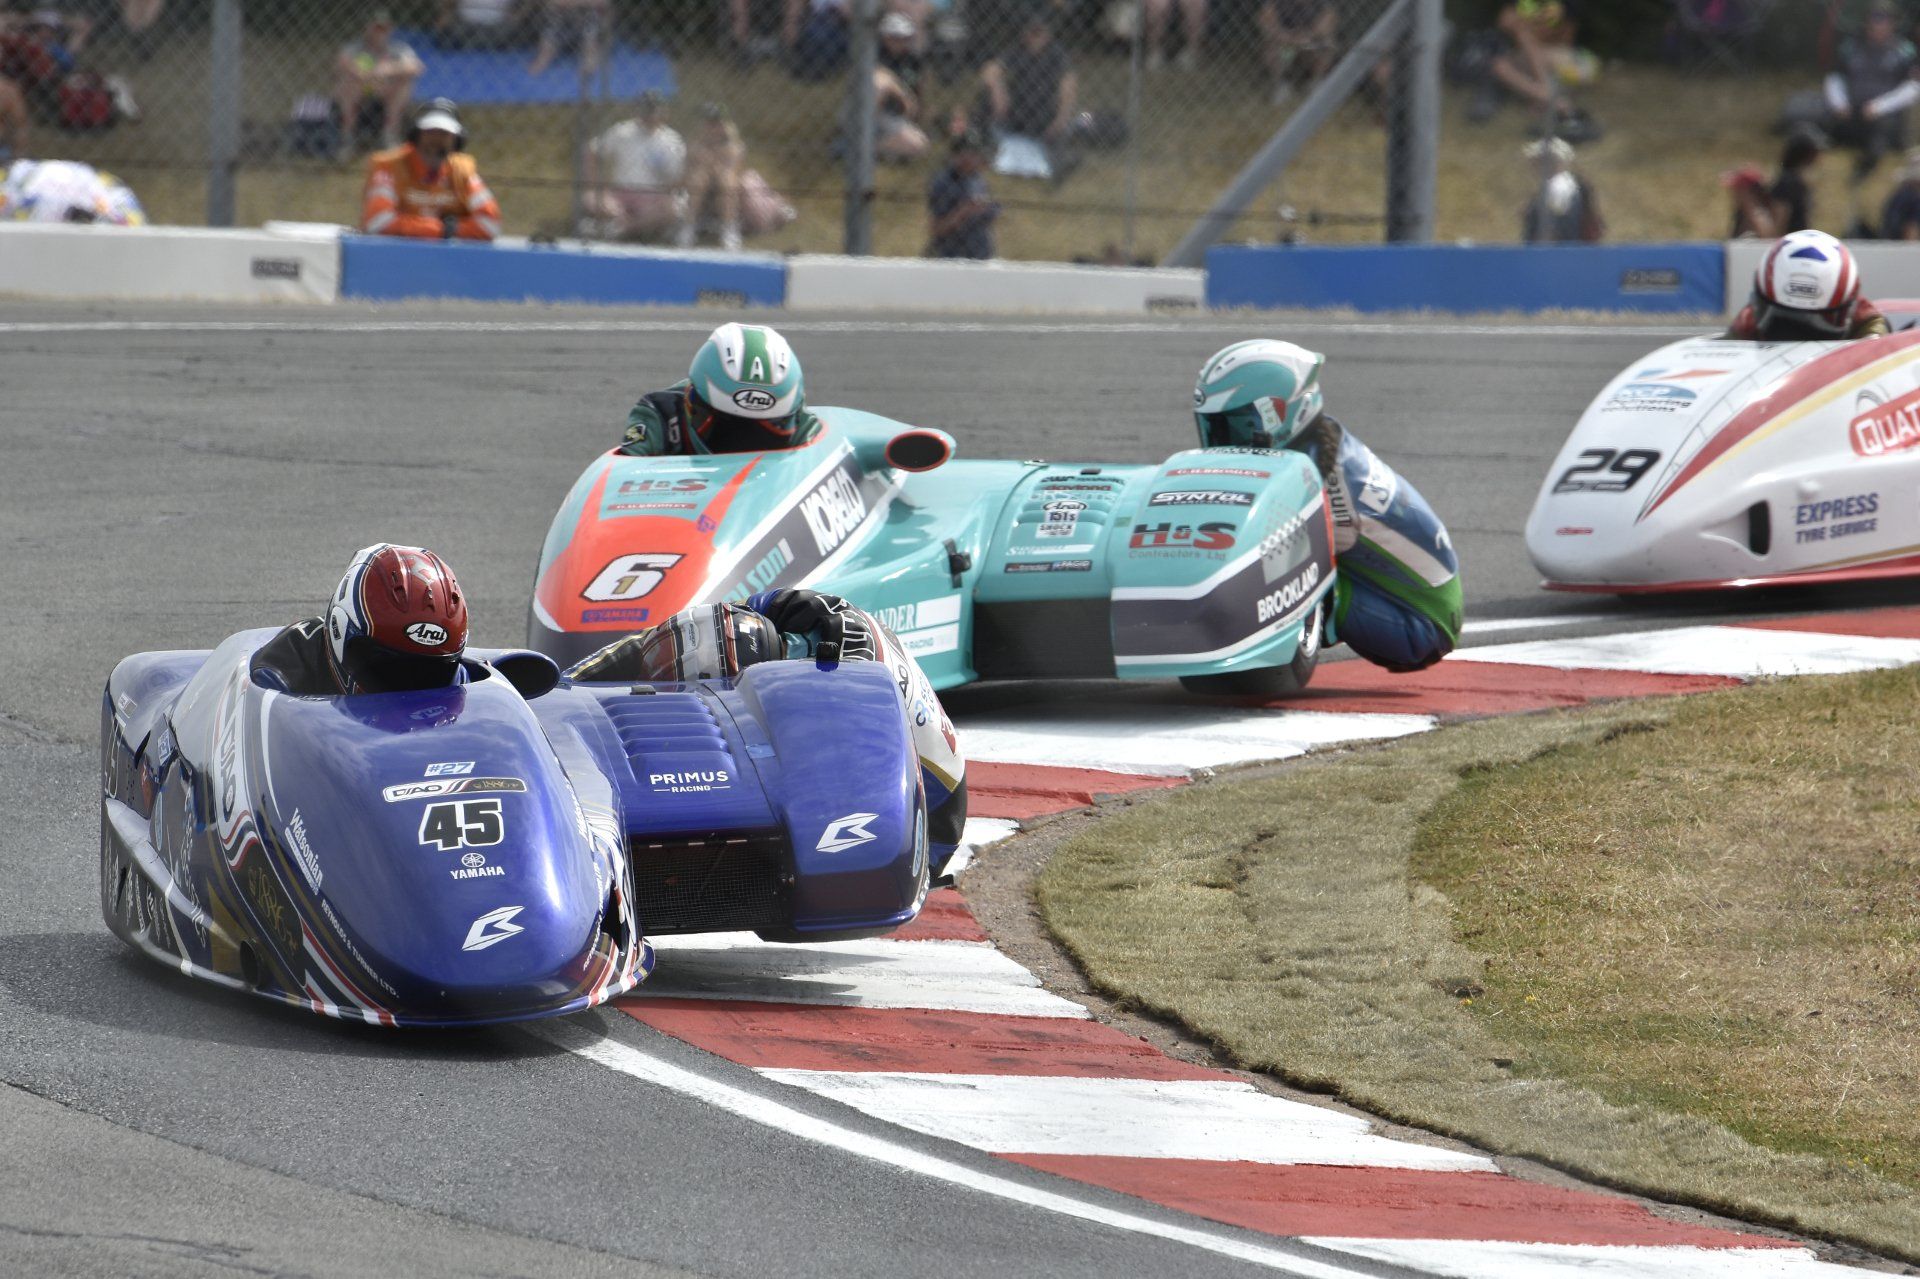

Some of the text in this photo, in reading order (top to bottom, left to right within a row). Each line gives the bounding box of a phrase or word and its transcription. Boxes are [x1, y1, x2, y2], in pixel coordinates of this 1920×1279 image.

[738, 392, 772, 405] Arai
[1551, 448, 1661, 494] 29
[1152, 491, 1250, 503] SYNTOL
[1796, 493, 1878, 525] EXPRESS
[1129, 522, 1237, 550] H&S
[1796, 518, 1877, 544] TYRE SERVICE
[579, 553, 687, 602] 6
[407, 624, 446, 641] Arai
[428, 762, 471, 775] #27
[650, 771, 728, 784] PRIMUS
[419, 799, 504, 850] 45
[289, 807, 324, 887] Watsonian
[450, 866, 505, 879] YAMAHA
[321, 899, 347, 944] REYNOLDS
[352, 946, 379, 982] TURNER
